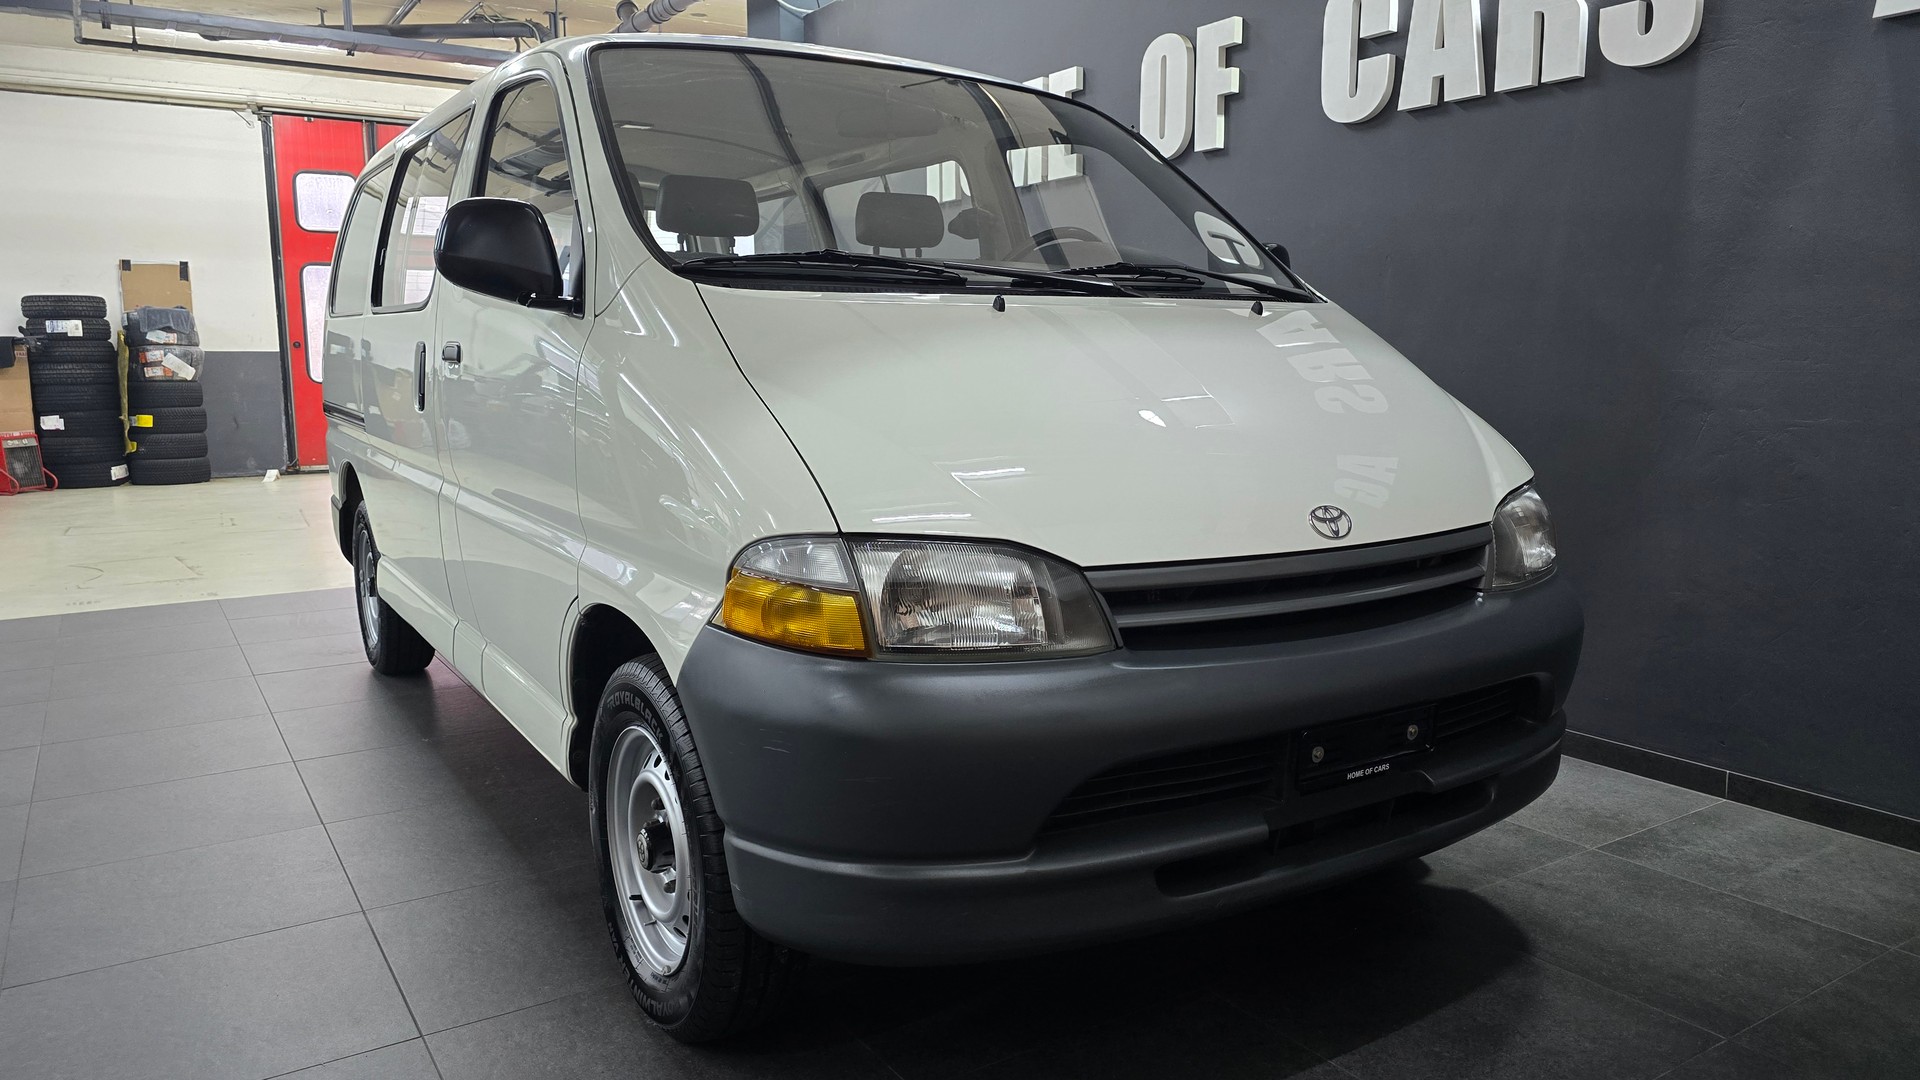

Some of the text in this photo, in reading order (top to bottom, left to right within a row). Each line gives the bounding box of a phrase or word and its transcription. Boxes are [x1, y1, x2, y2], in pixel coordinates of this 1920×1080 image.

[1135, 16, 1243, 163] OF
[1347, 763, 1390, 780] HOME OF CARS
